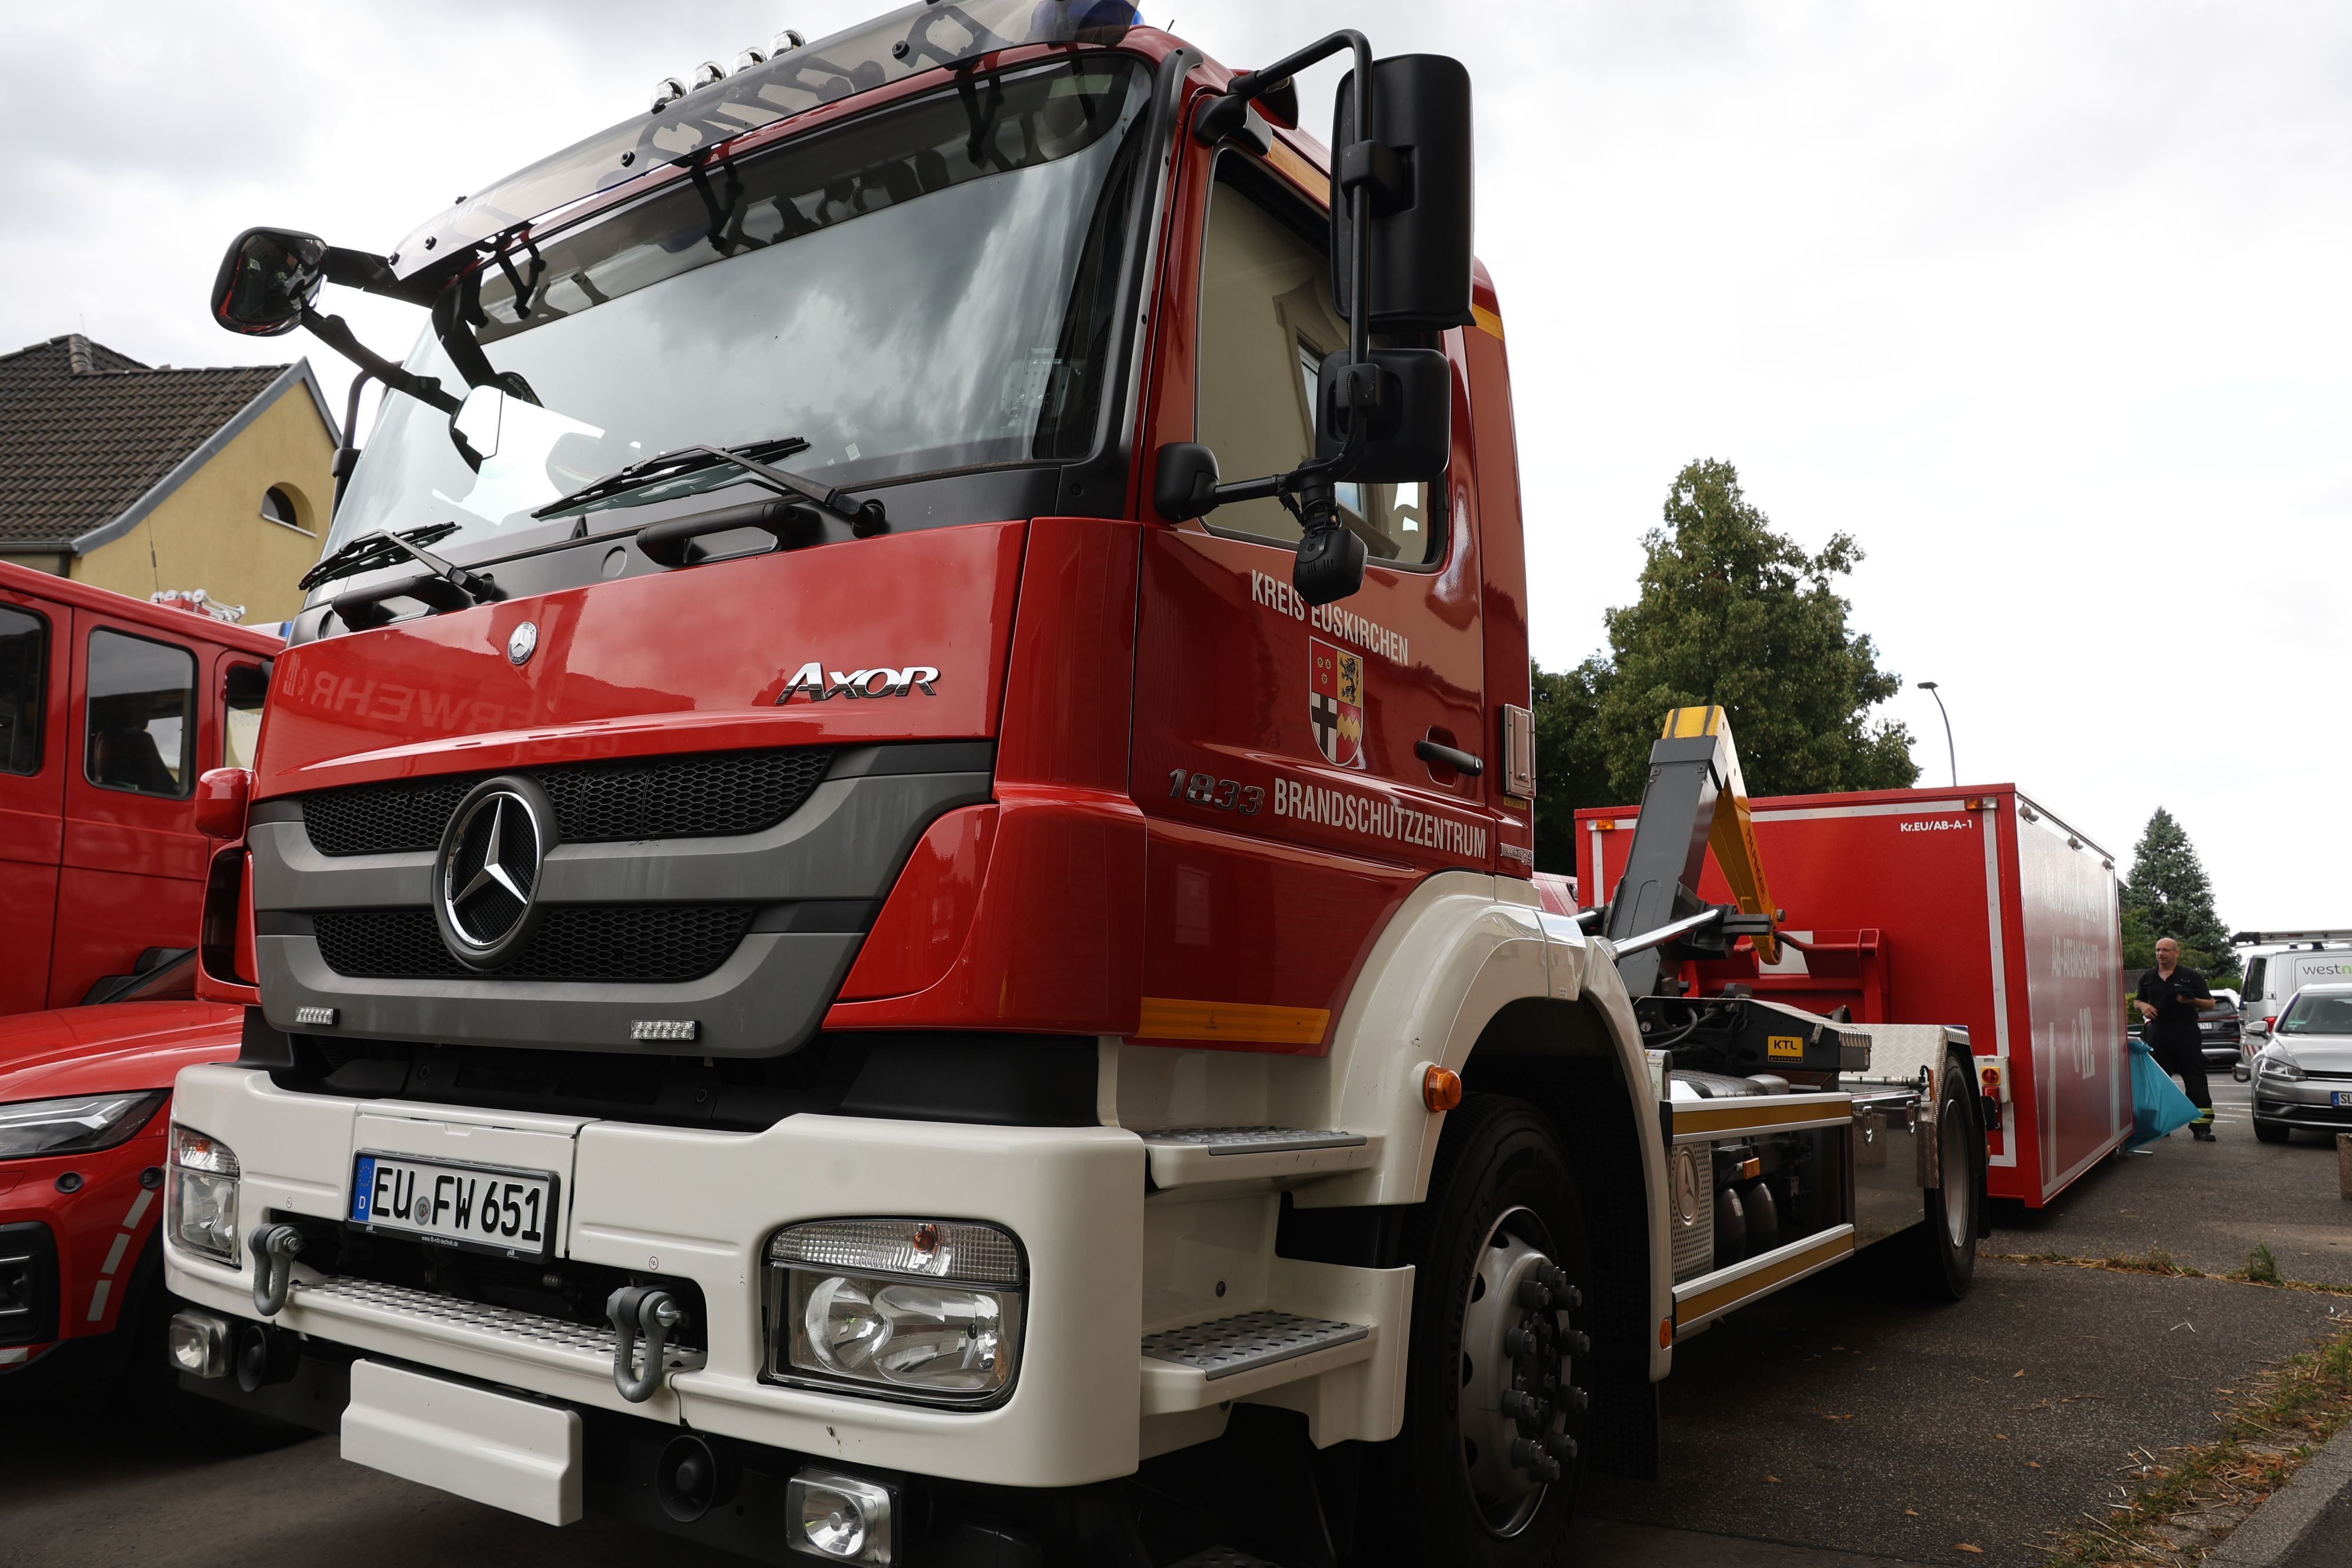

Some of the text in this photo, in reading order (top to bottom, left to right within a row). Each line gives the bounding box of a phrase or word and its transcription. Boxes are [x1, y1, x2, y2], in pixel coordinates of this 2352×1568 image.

[1252, 570, 1409, 666] KREIS EUSKIRCHEN
[1168, 768, 1265, 815] 1833
[1509, 798, 1521, 808] 230V
[1274, 778, 1486, 859] BRANDSCHUTZZENTRUM
[1900, 820, 1973, 833] Kr.EU/AB-A-1
[2052, 935, 2100, 979] AB-ATEMSCHUTZ
[1774, 1039, 1798, 1051] KTL
[2079, 1006, 2096, 1079] 112
[359, 1166, 542, 1242] D EU FW 651
